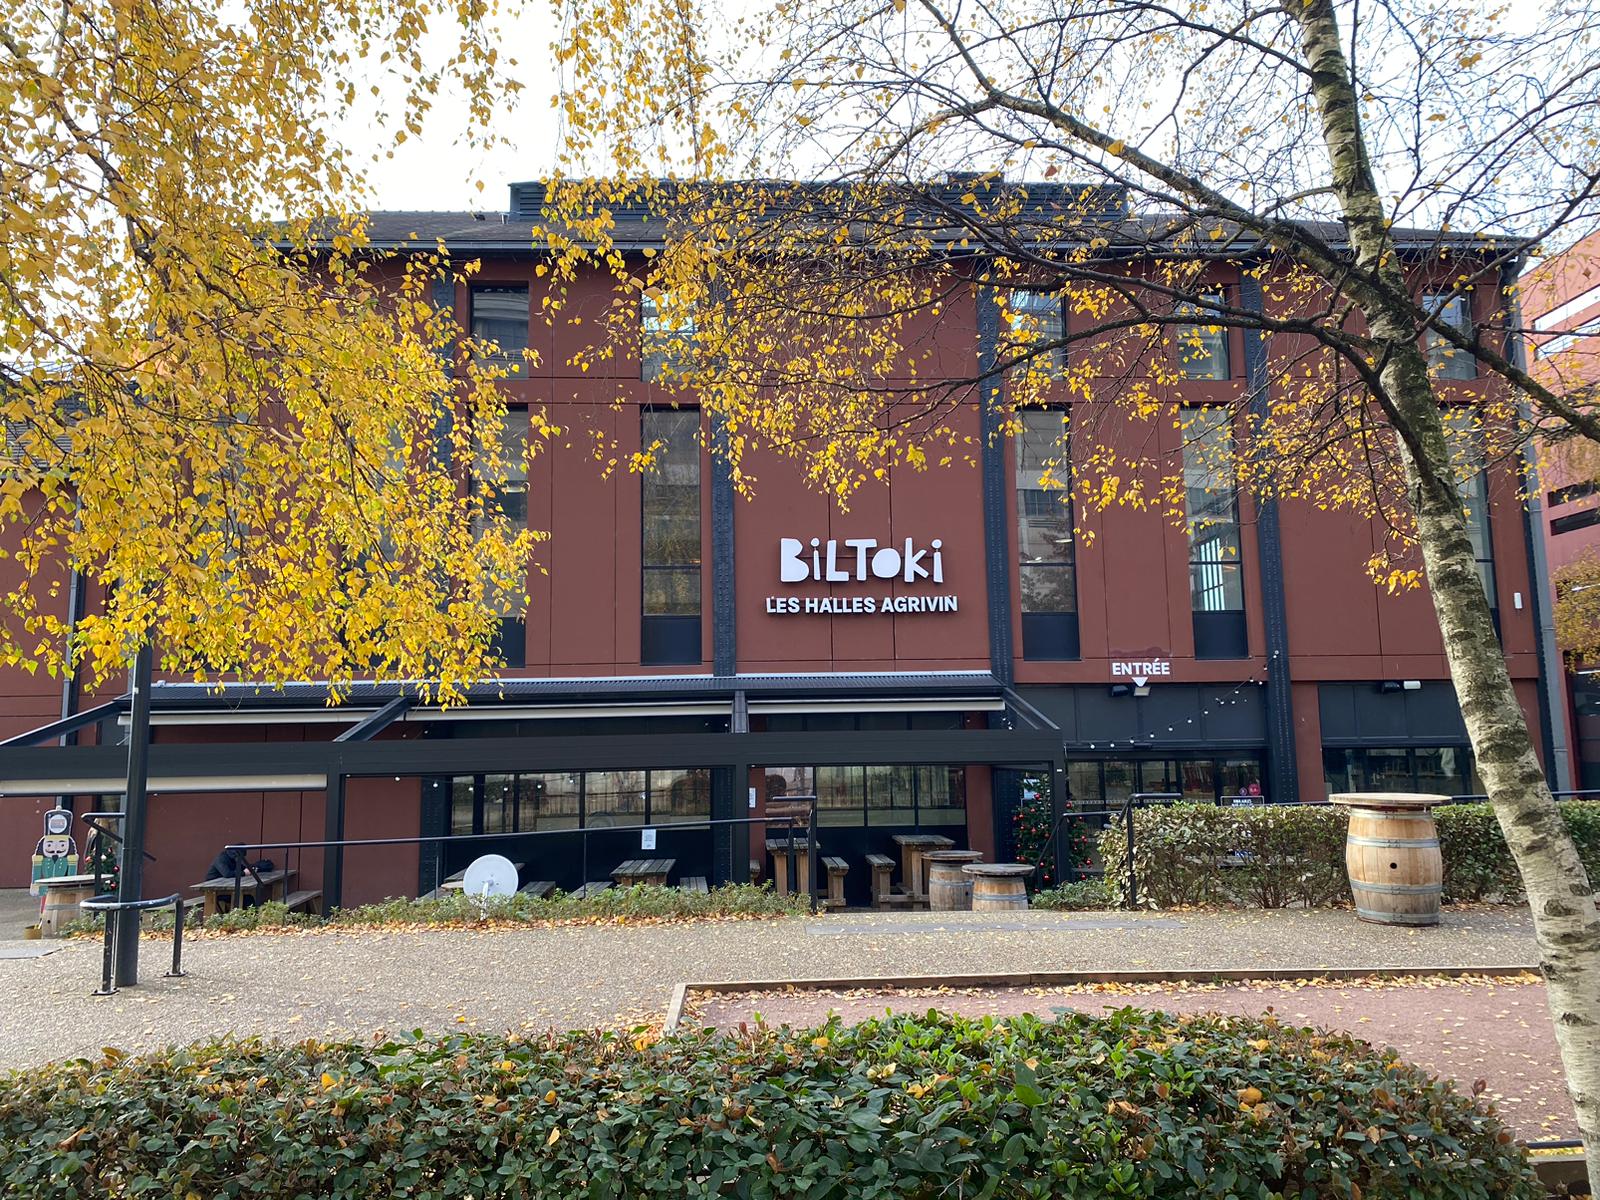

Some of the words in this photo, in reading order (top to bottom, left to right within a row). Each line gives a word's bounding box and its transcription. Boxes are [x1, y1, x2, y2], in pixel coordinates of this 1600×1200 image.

[766, 597, 800, 614] LES
[805, 597, 876, 614] HALLES
[881, 596, 958, 613] AGRIVIN
[1112, 657, 1170, 675] ENTRÉE
